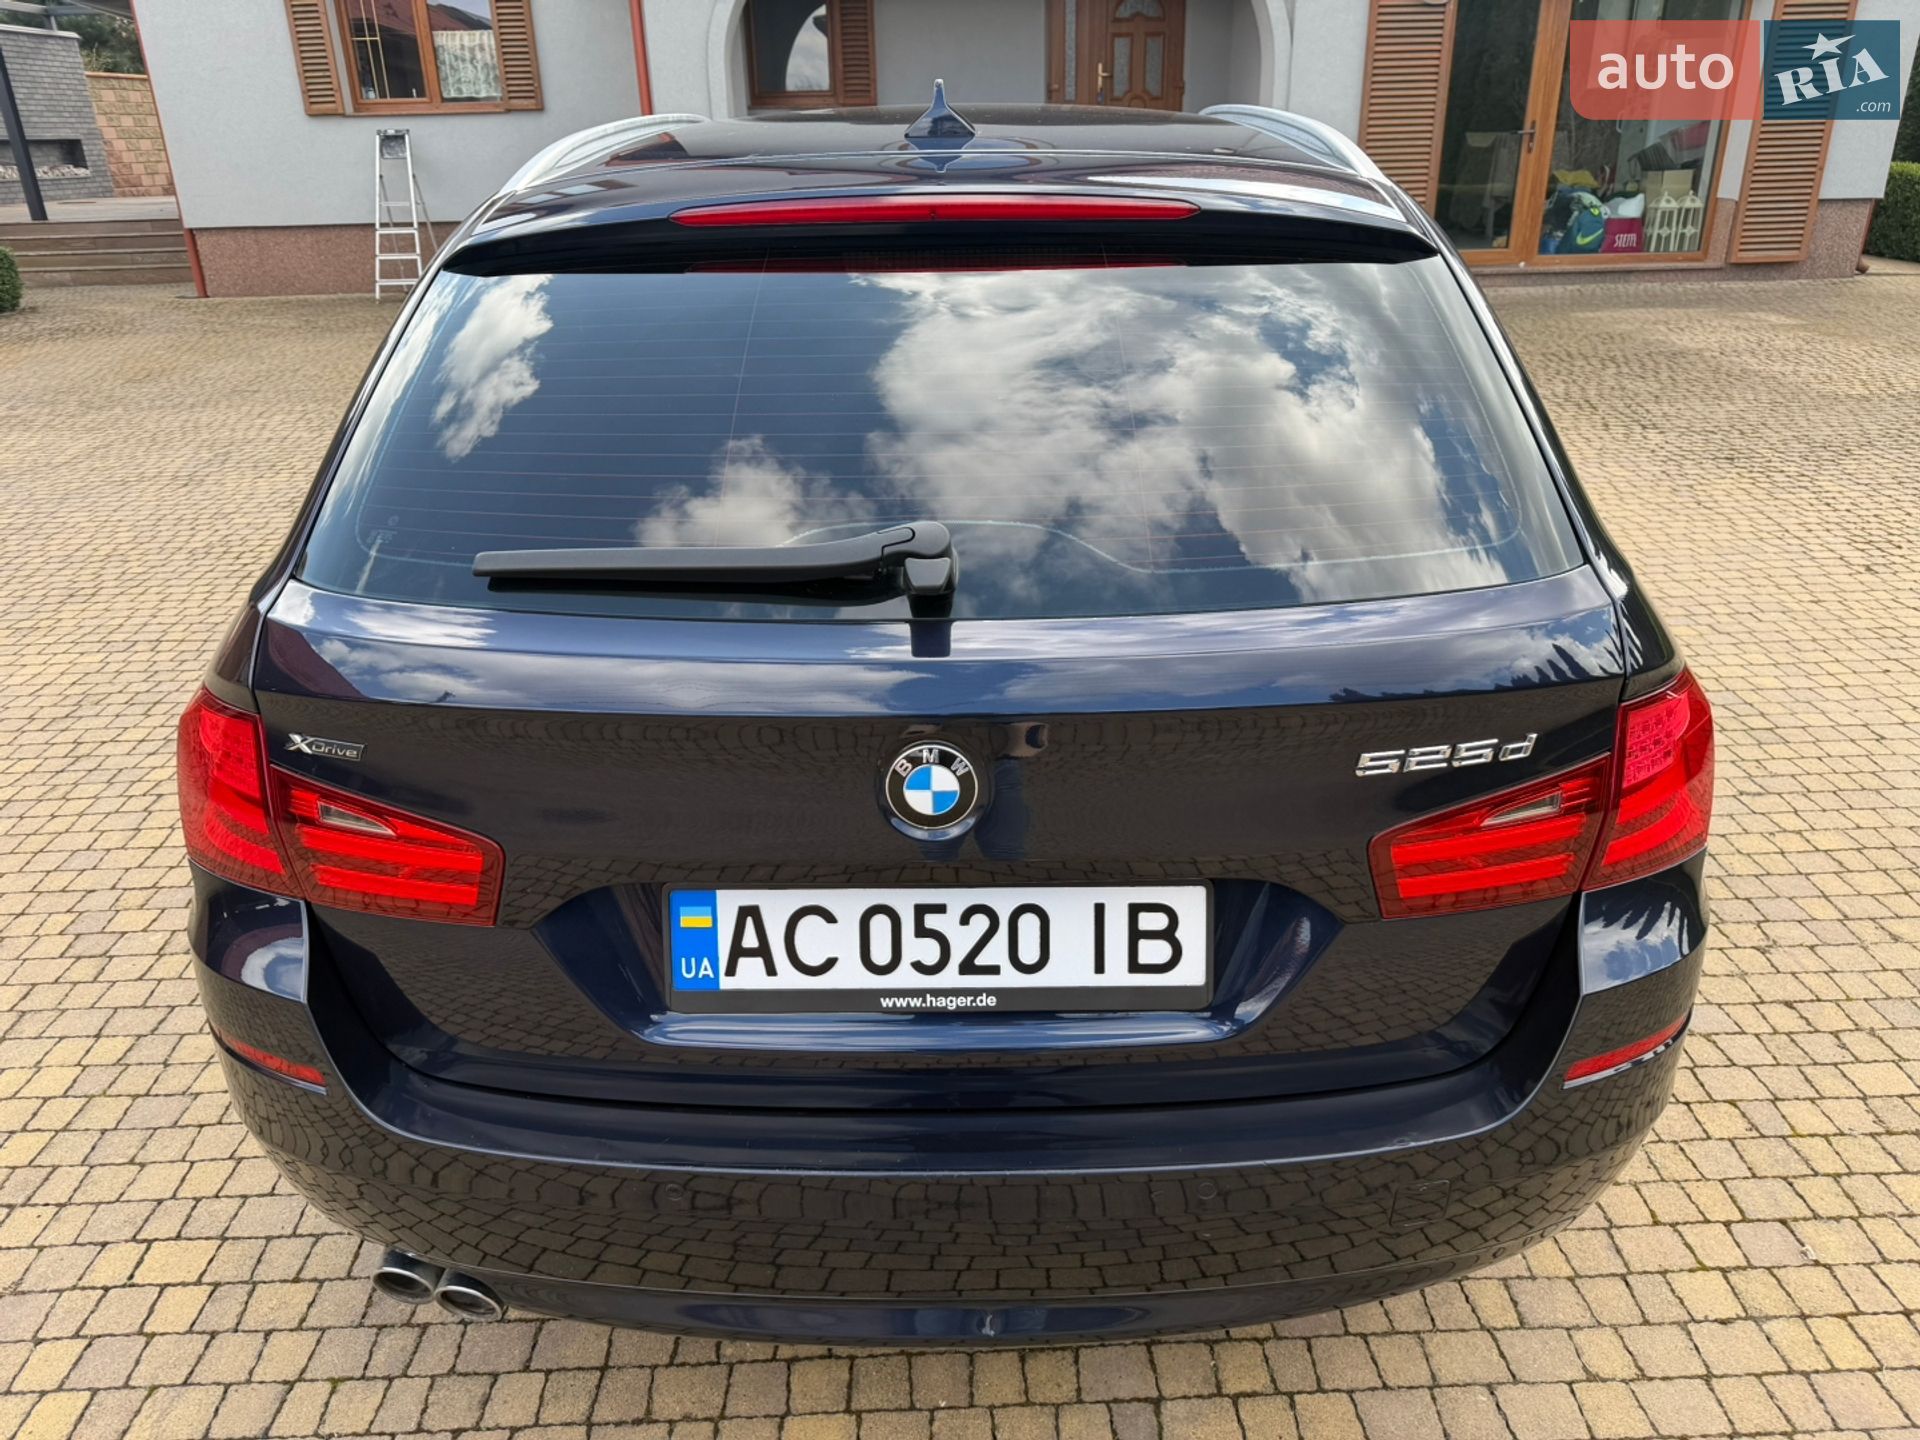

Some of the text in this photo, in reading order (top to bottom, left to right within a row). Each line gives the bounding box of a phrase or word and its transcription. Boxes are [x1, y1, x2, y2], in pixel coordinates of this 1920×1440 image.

[894, 747, 970, 778] BMW
[1355, 733, 1538, 777] 525d
[724, 901, 1183, 977] AC 0520 IB
[681, 956, 715, 979] UA
[879, 992, 997, 1011] www.hager.de
